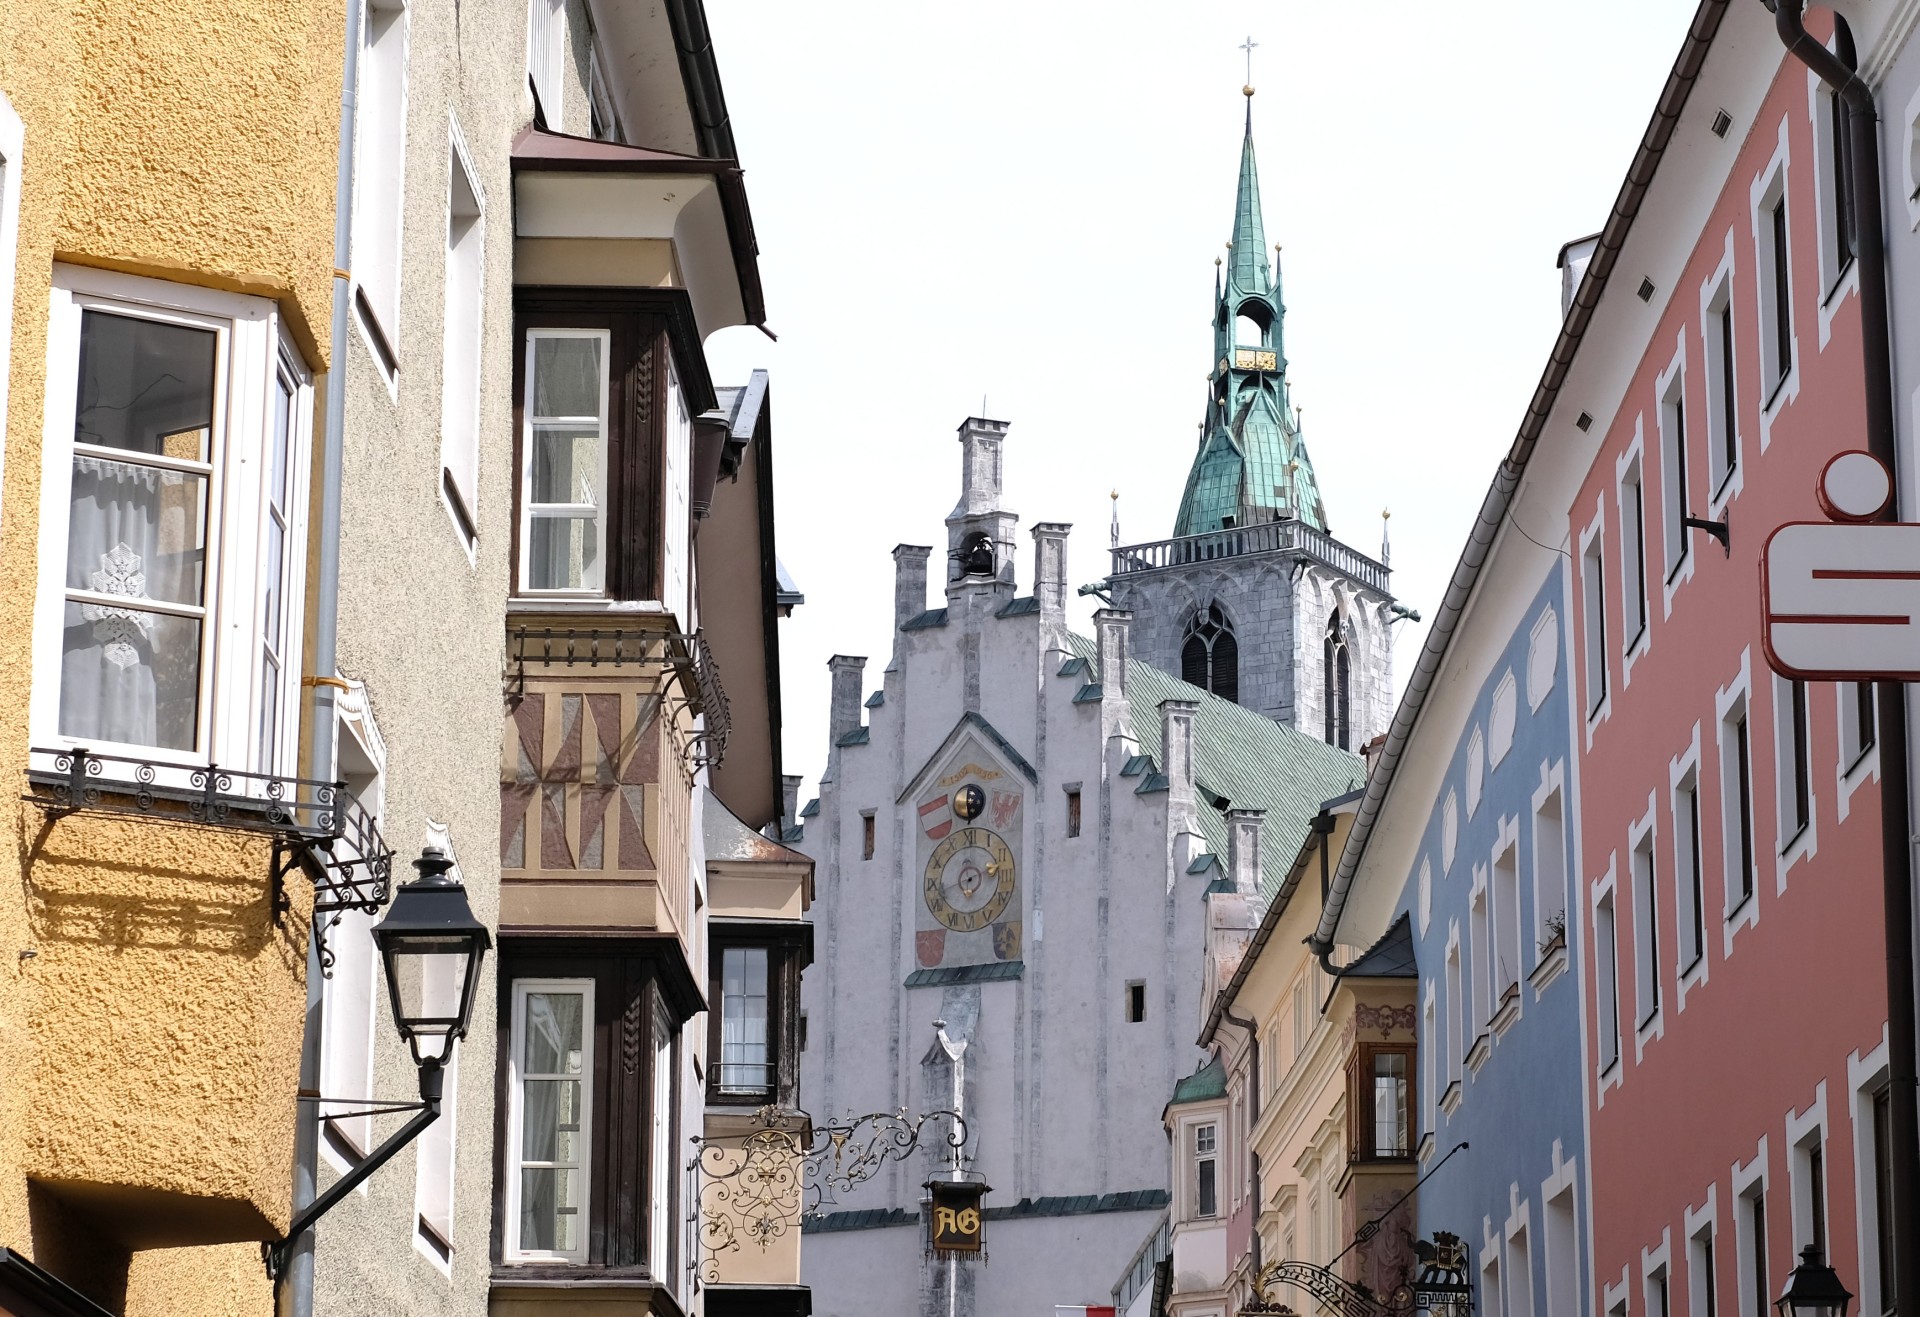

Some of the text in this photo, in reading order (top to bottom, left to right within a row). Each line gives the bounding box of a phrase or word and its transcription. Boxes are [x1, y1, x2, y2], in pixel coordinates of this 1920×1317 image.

[963, 830, 977, 845] XII
[933, 855, 942, 869] X
[998, 848, 1006, 862] II
[1001, 868, 1013, 883] III
[927, 878, 938, 892] IX
[998, 891, 1010, 905] IV
[947, 913, 958, 926] VII
[963, 915, 975, 928] VI
[982, 909, 993, 922] V
